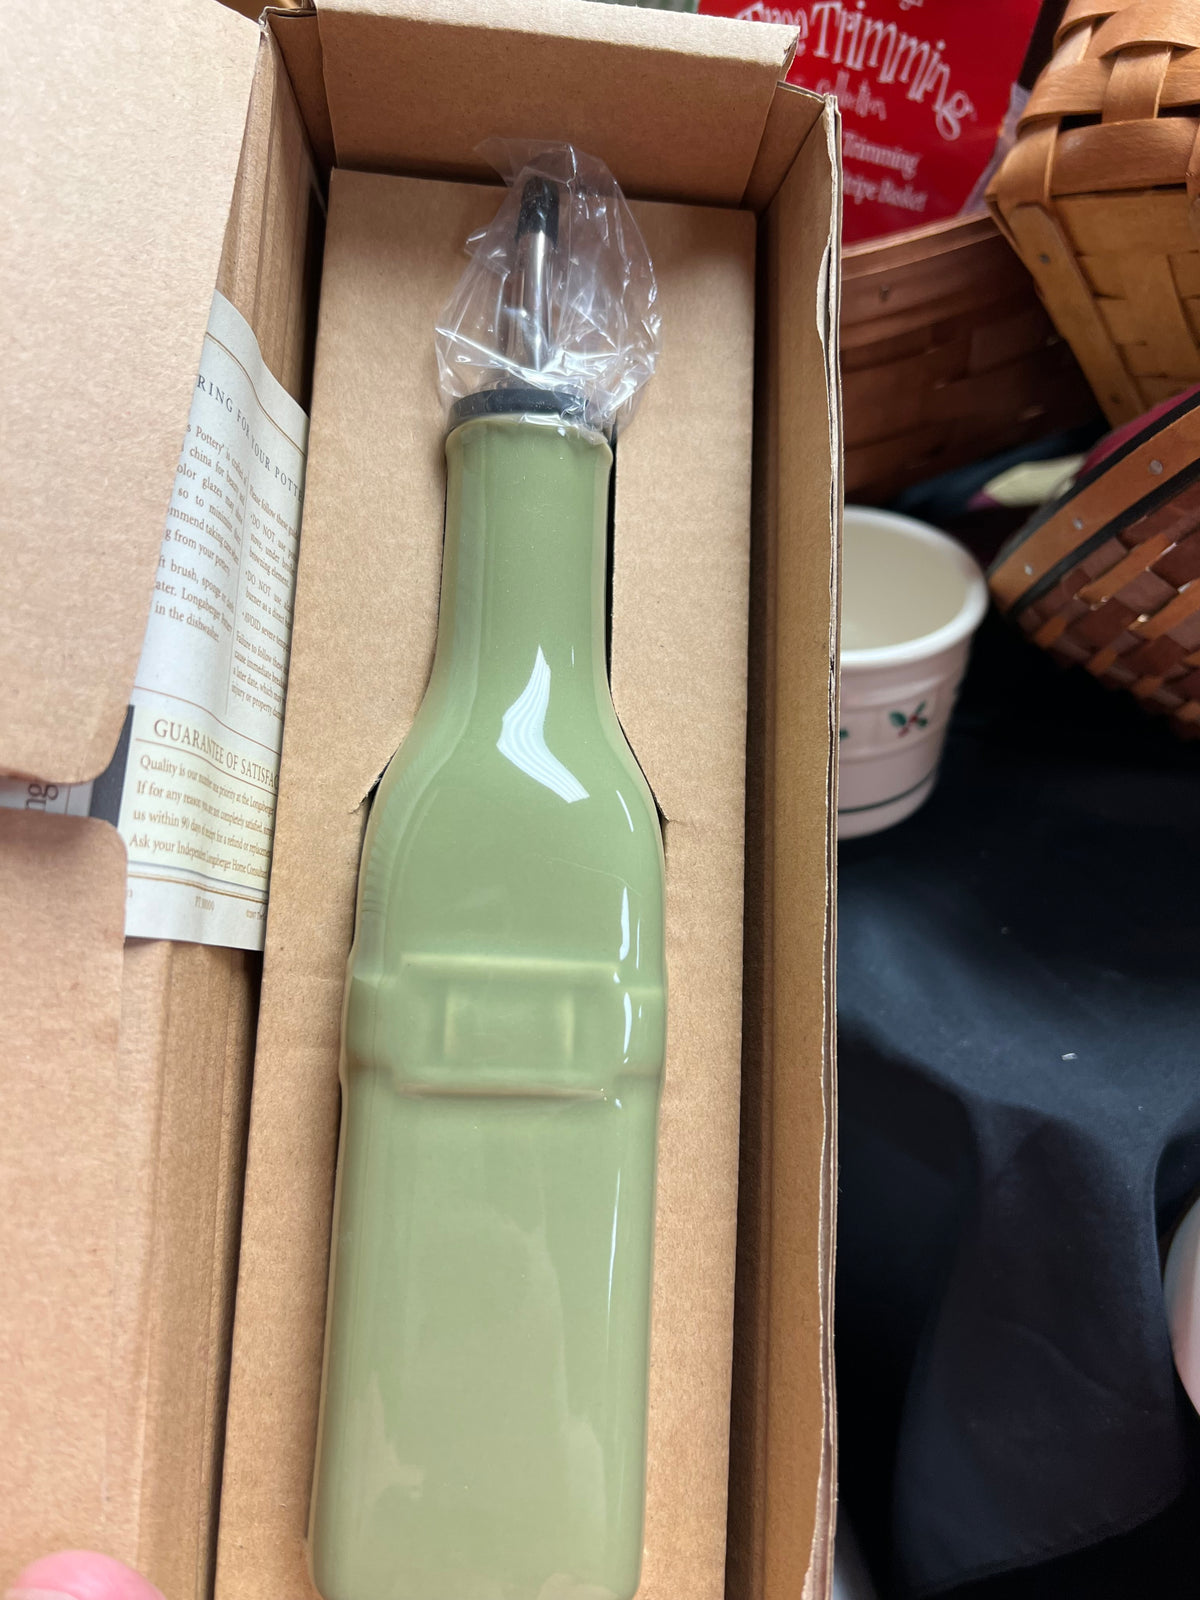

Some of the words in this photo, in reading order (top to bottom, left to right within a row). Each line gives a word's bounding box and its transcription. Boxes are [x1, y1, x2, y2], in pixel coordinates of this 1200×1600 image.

[736, 1, 808, 56] Te
[811, 0, 976, 141] Trimming
[236, 409, 251, 440] FOR
[250, 434, 270, 472] YOUR
[189, 446, 212, 467] china
[178, 487, 189, 500] so
[195, 495, 205, 508] to
[168, 507, 205, 531] mmend
[174, 529, 197, 550] from
[263, 523, 275, 543] NOT
[170, 558, 199, 585] brush,
[155, 601, 166, 616] in
[169, 606, 185, 622] the
[153, 718, 225, 765] GUARANTEE
[226, 751, 239, 771] OF
[140, 754, 179, 779] Quality
[179, 761, 186, 778] is
[136, 779, 146, 795] If
[147, 780, 164, 798] for
[165, 789, 183, 805] any
[133, 809, 146, 821] us
[148, 809, 180, 828] within
[129, 833, 151, 850] Ask
[152, 839, 176, 854] your
